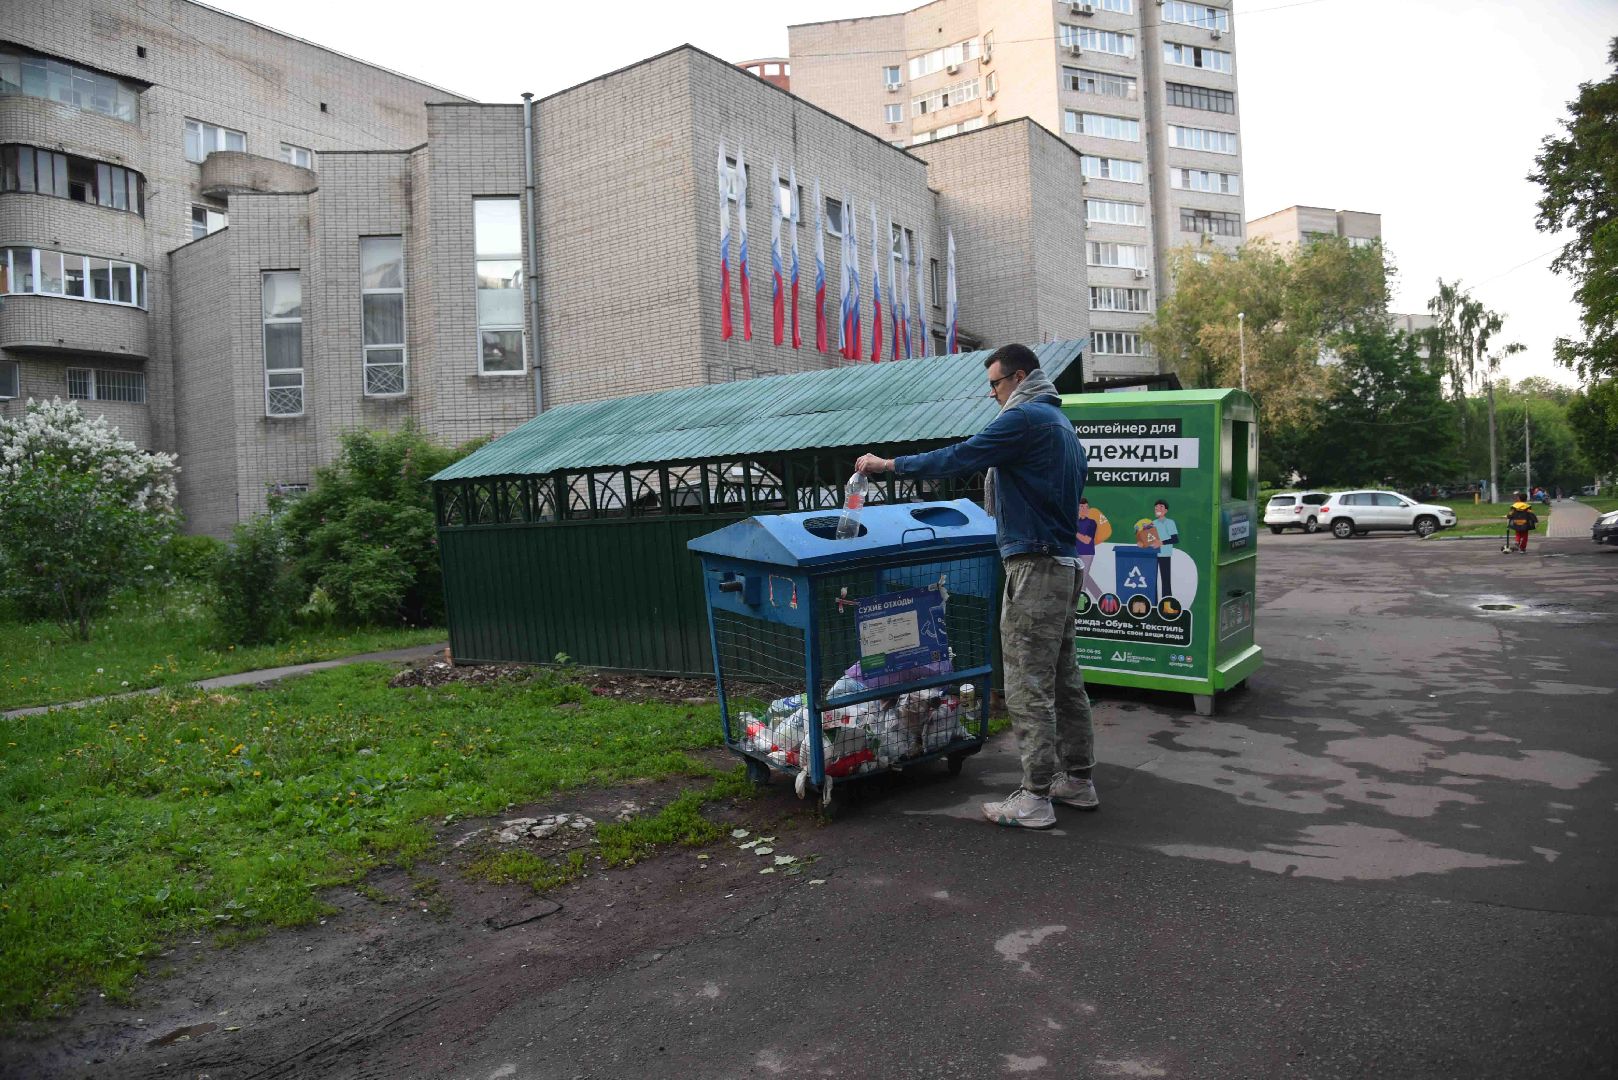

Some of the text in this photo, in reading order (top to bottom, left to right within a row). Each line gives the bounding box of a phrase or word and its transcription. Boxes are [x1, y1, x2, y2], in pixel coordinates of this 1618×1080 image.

[1075, 423, 1176, 435] контейнер для
[1094, 471, 1170, 482] текстиля
[858, 597, 913, 614] СУХИЕ ОТХОДЫ
[1105, 619, 1134, 629] Обувь
[1140, 622, 1184, 633] Текстиль
